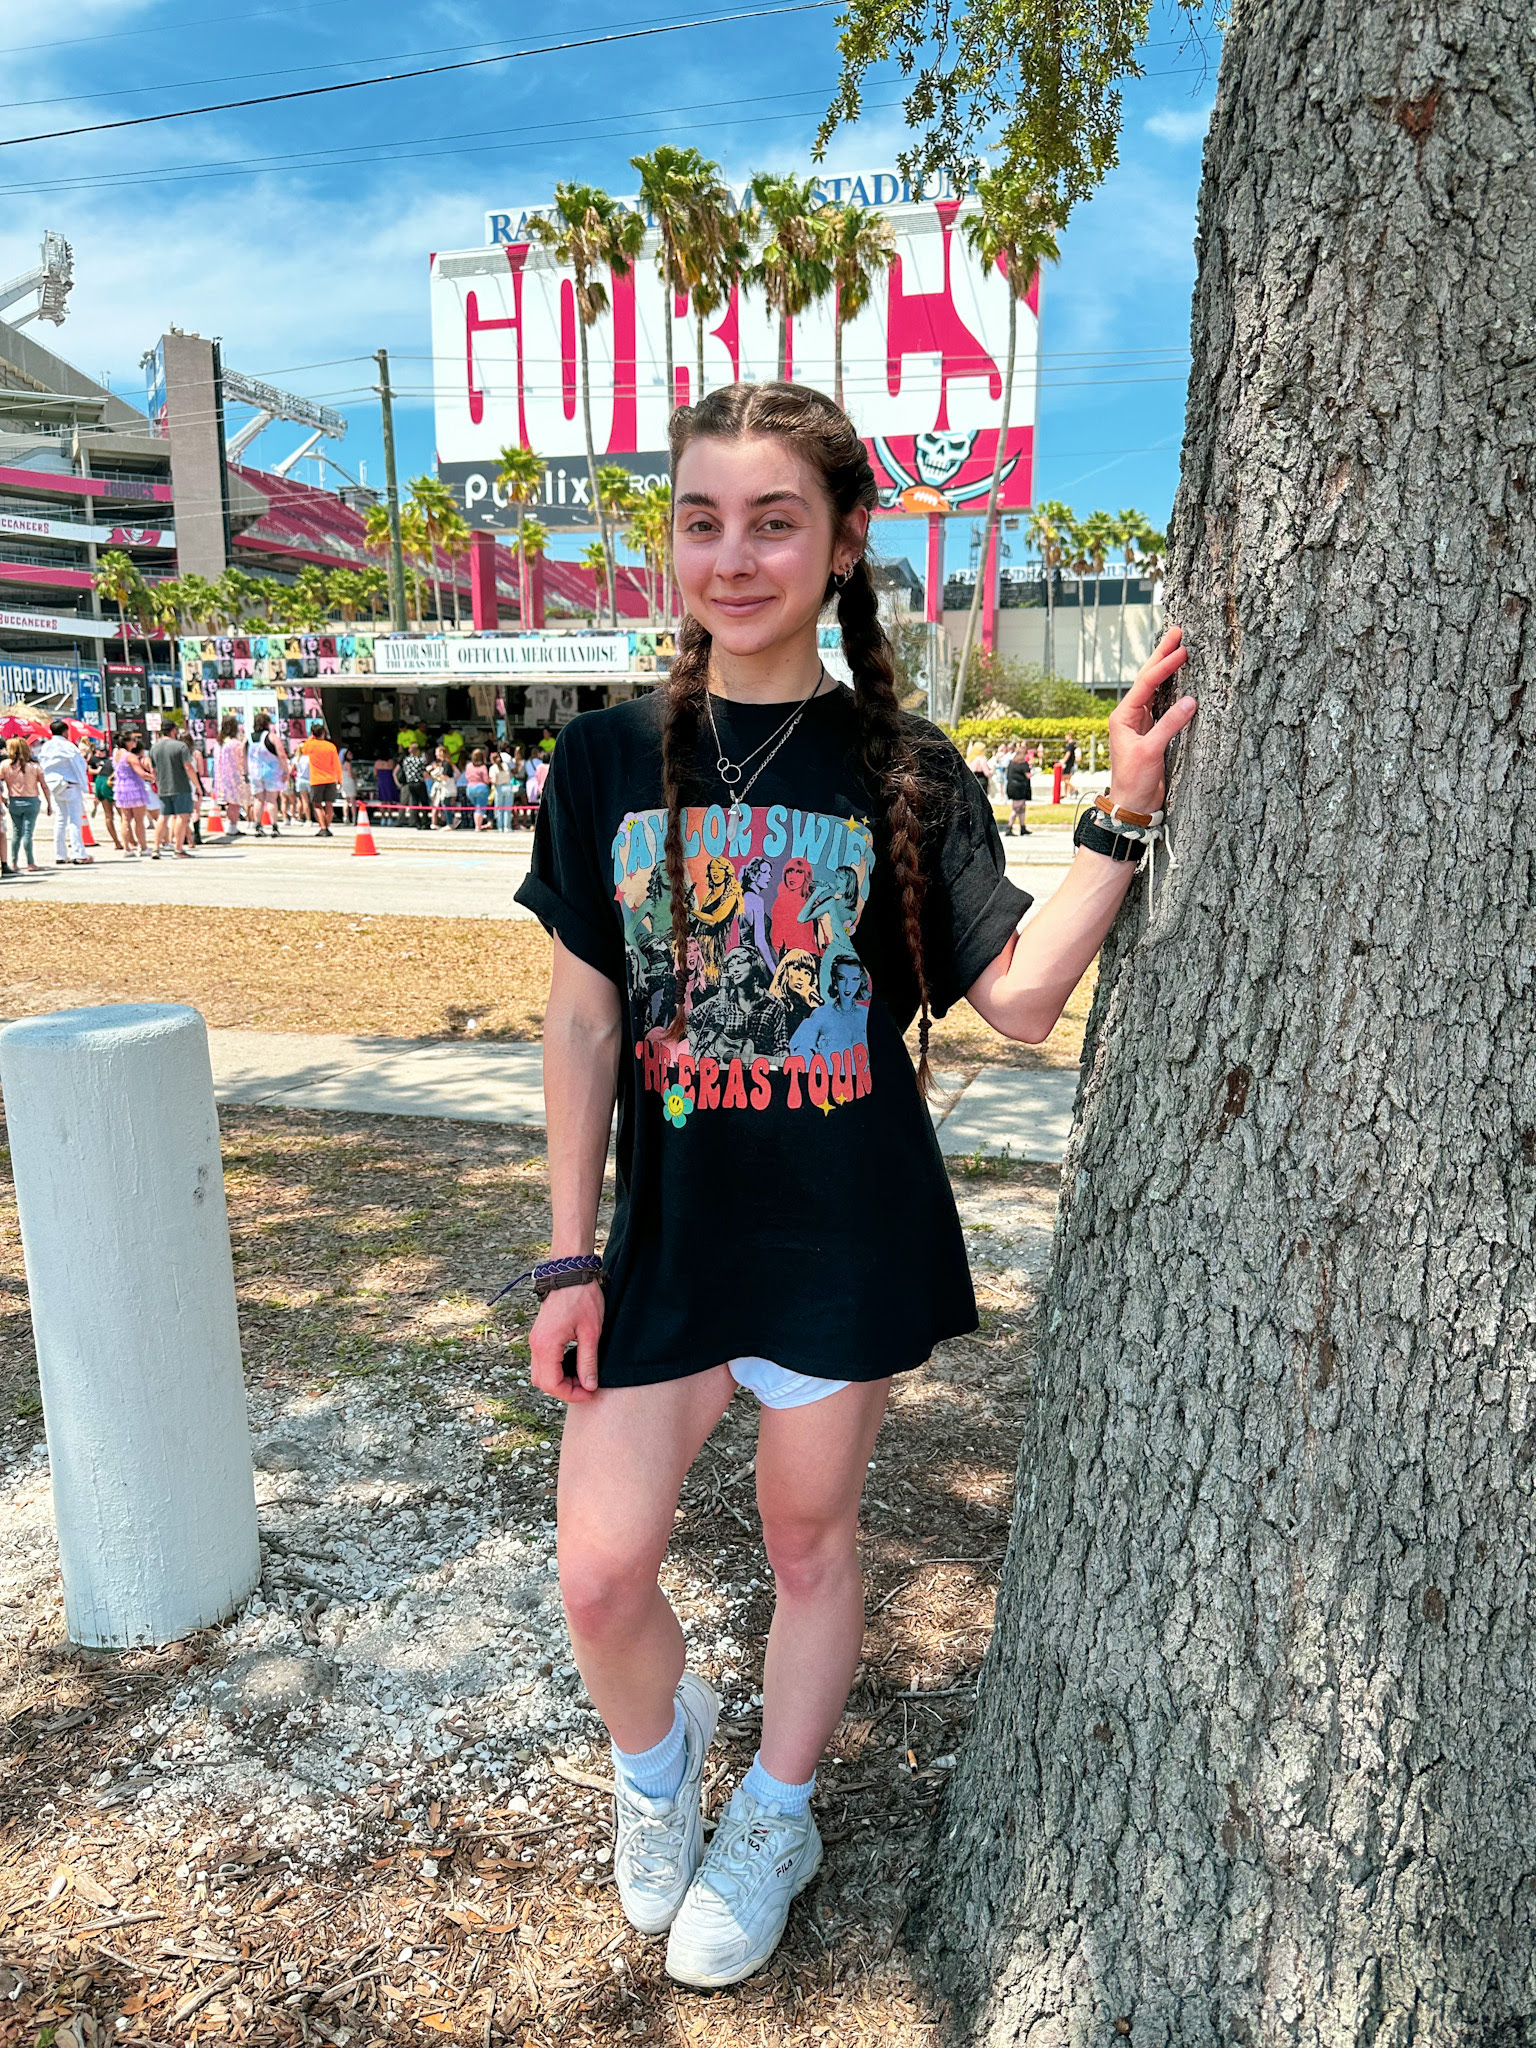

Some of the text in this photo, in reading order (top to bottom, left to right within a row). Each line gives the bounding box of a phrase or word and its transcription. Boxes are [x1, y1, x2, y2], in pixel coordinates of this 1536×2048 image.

[0, 613, 58, 630] BUCCANEERS
[384, 643, 448, 660] TAYLOR SWIFT
[458, 646, 617, 664] OFFICIAL MERCHANDISE
[386, 660, 450, 669] THE ERAS TOUR
[35, 668, 72, 694] BANK
[611, 803, 752, 885] TAYLOR
[678, 1053, 771, 1110] ERAS
[783, 1043, 872, 1109] TOUR
[775, 1858, 793, 1878] FILA
